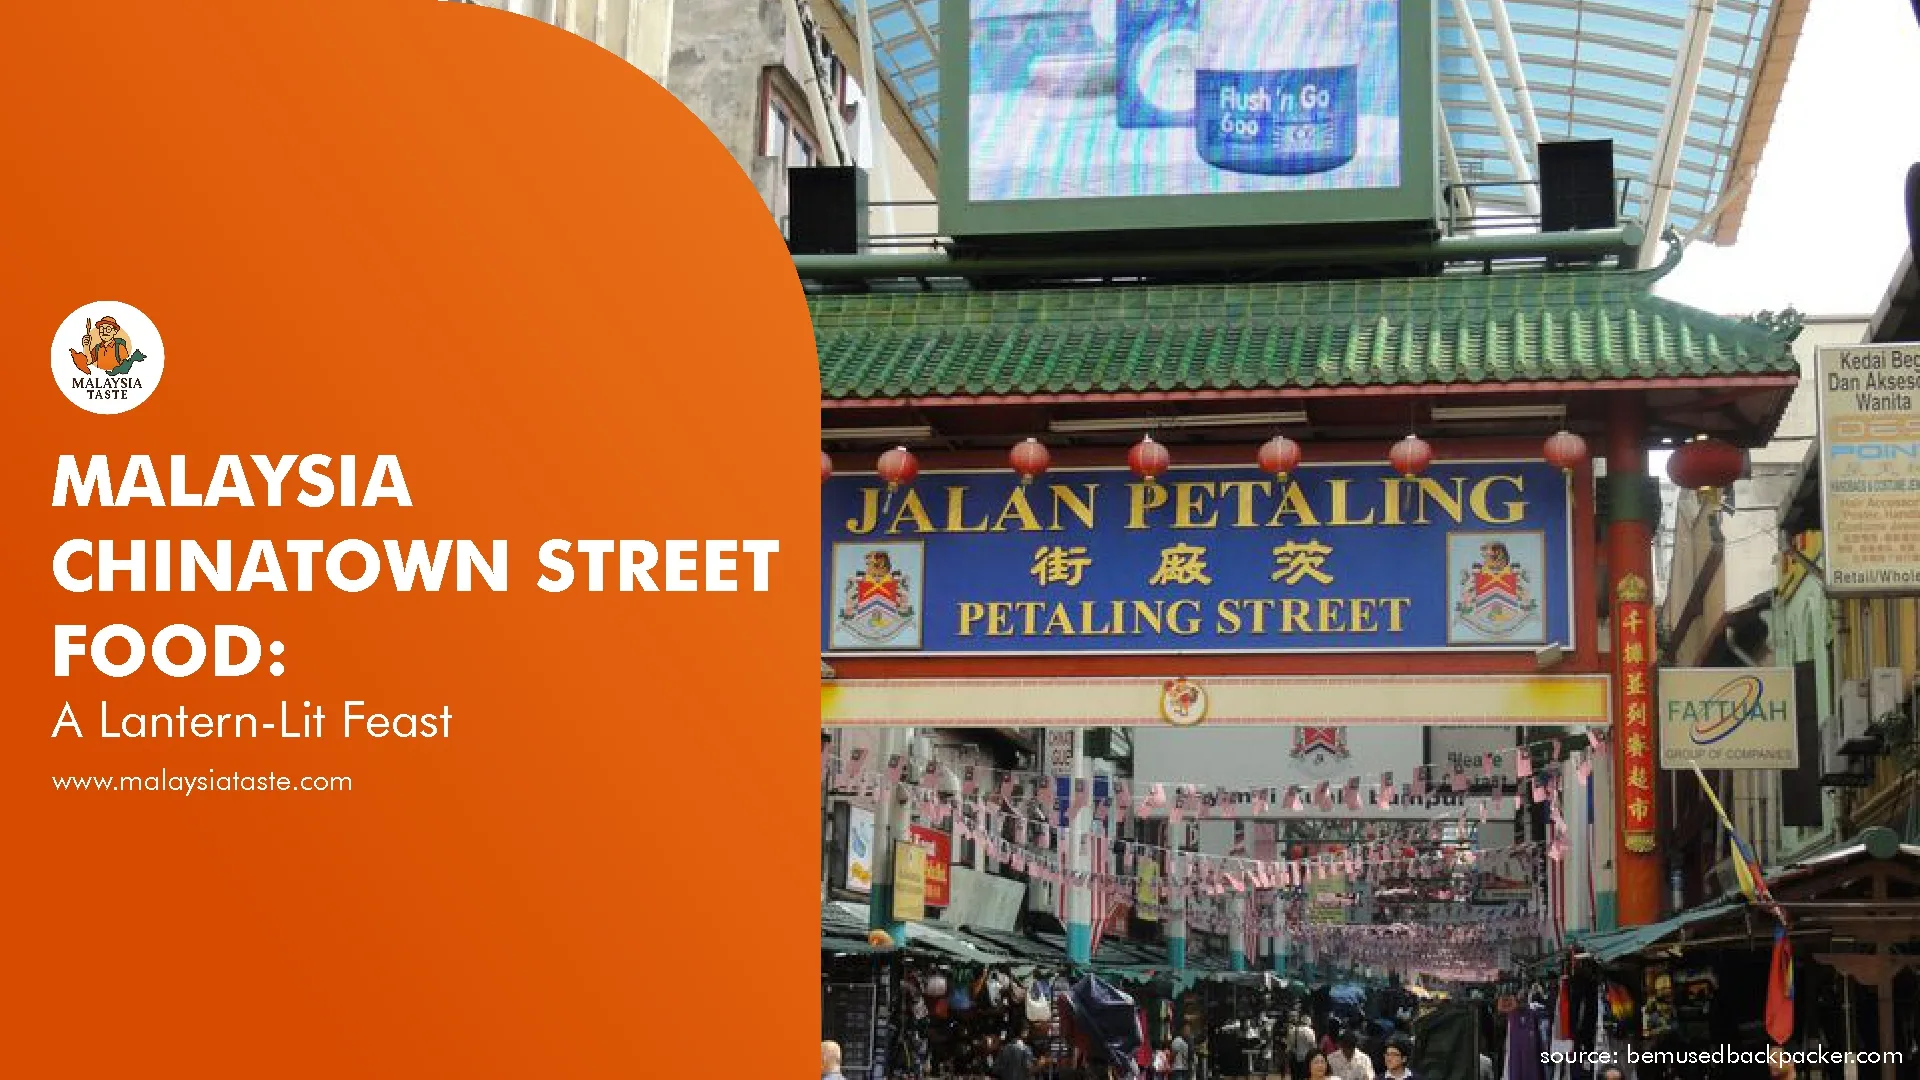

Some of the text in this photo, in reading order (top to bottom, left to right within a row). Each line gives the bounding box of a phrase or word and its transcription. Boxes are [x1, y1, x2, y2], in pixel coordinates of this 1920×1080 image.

[1301, 83, 1330, 109] Go
[1841, 351, 1886, 369] Kedai
[1828, 373, 1860, 391] Dan
[1856, 393, 1911, 411] Wanita
[846, 475, 1530, 534] JALAN PETALING
[957, 597, 1411, 636] PETALING STREET
[1668, 700, 1787, 721] FATTUAH
